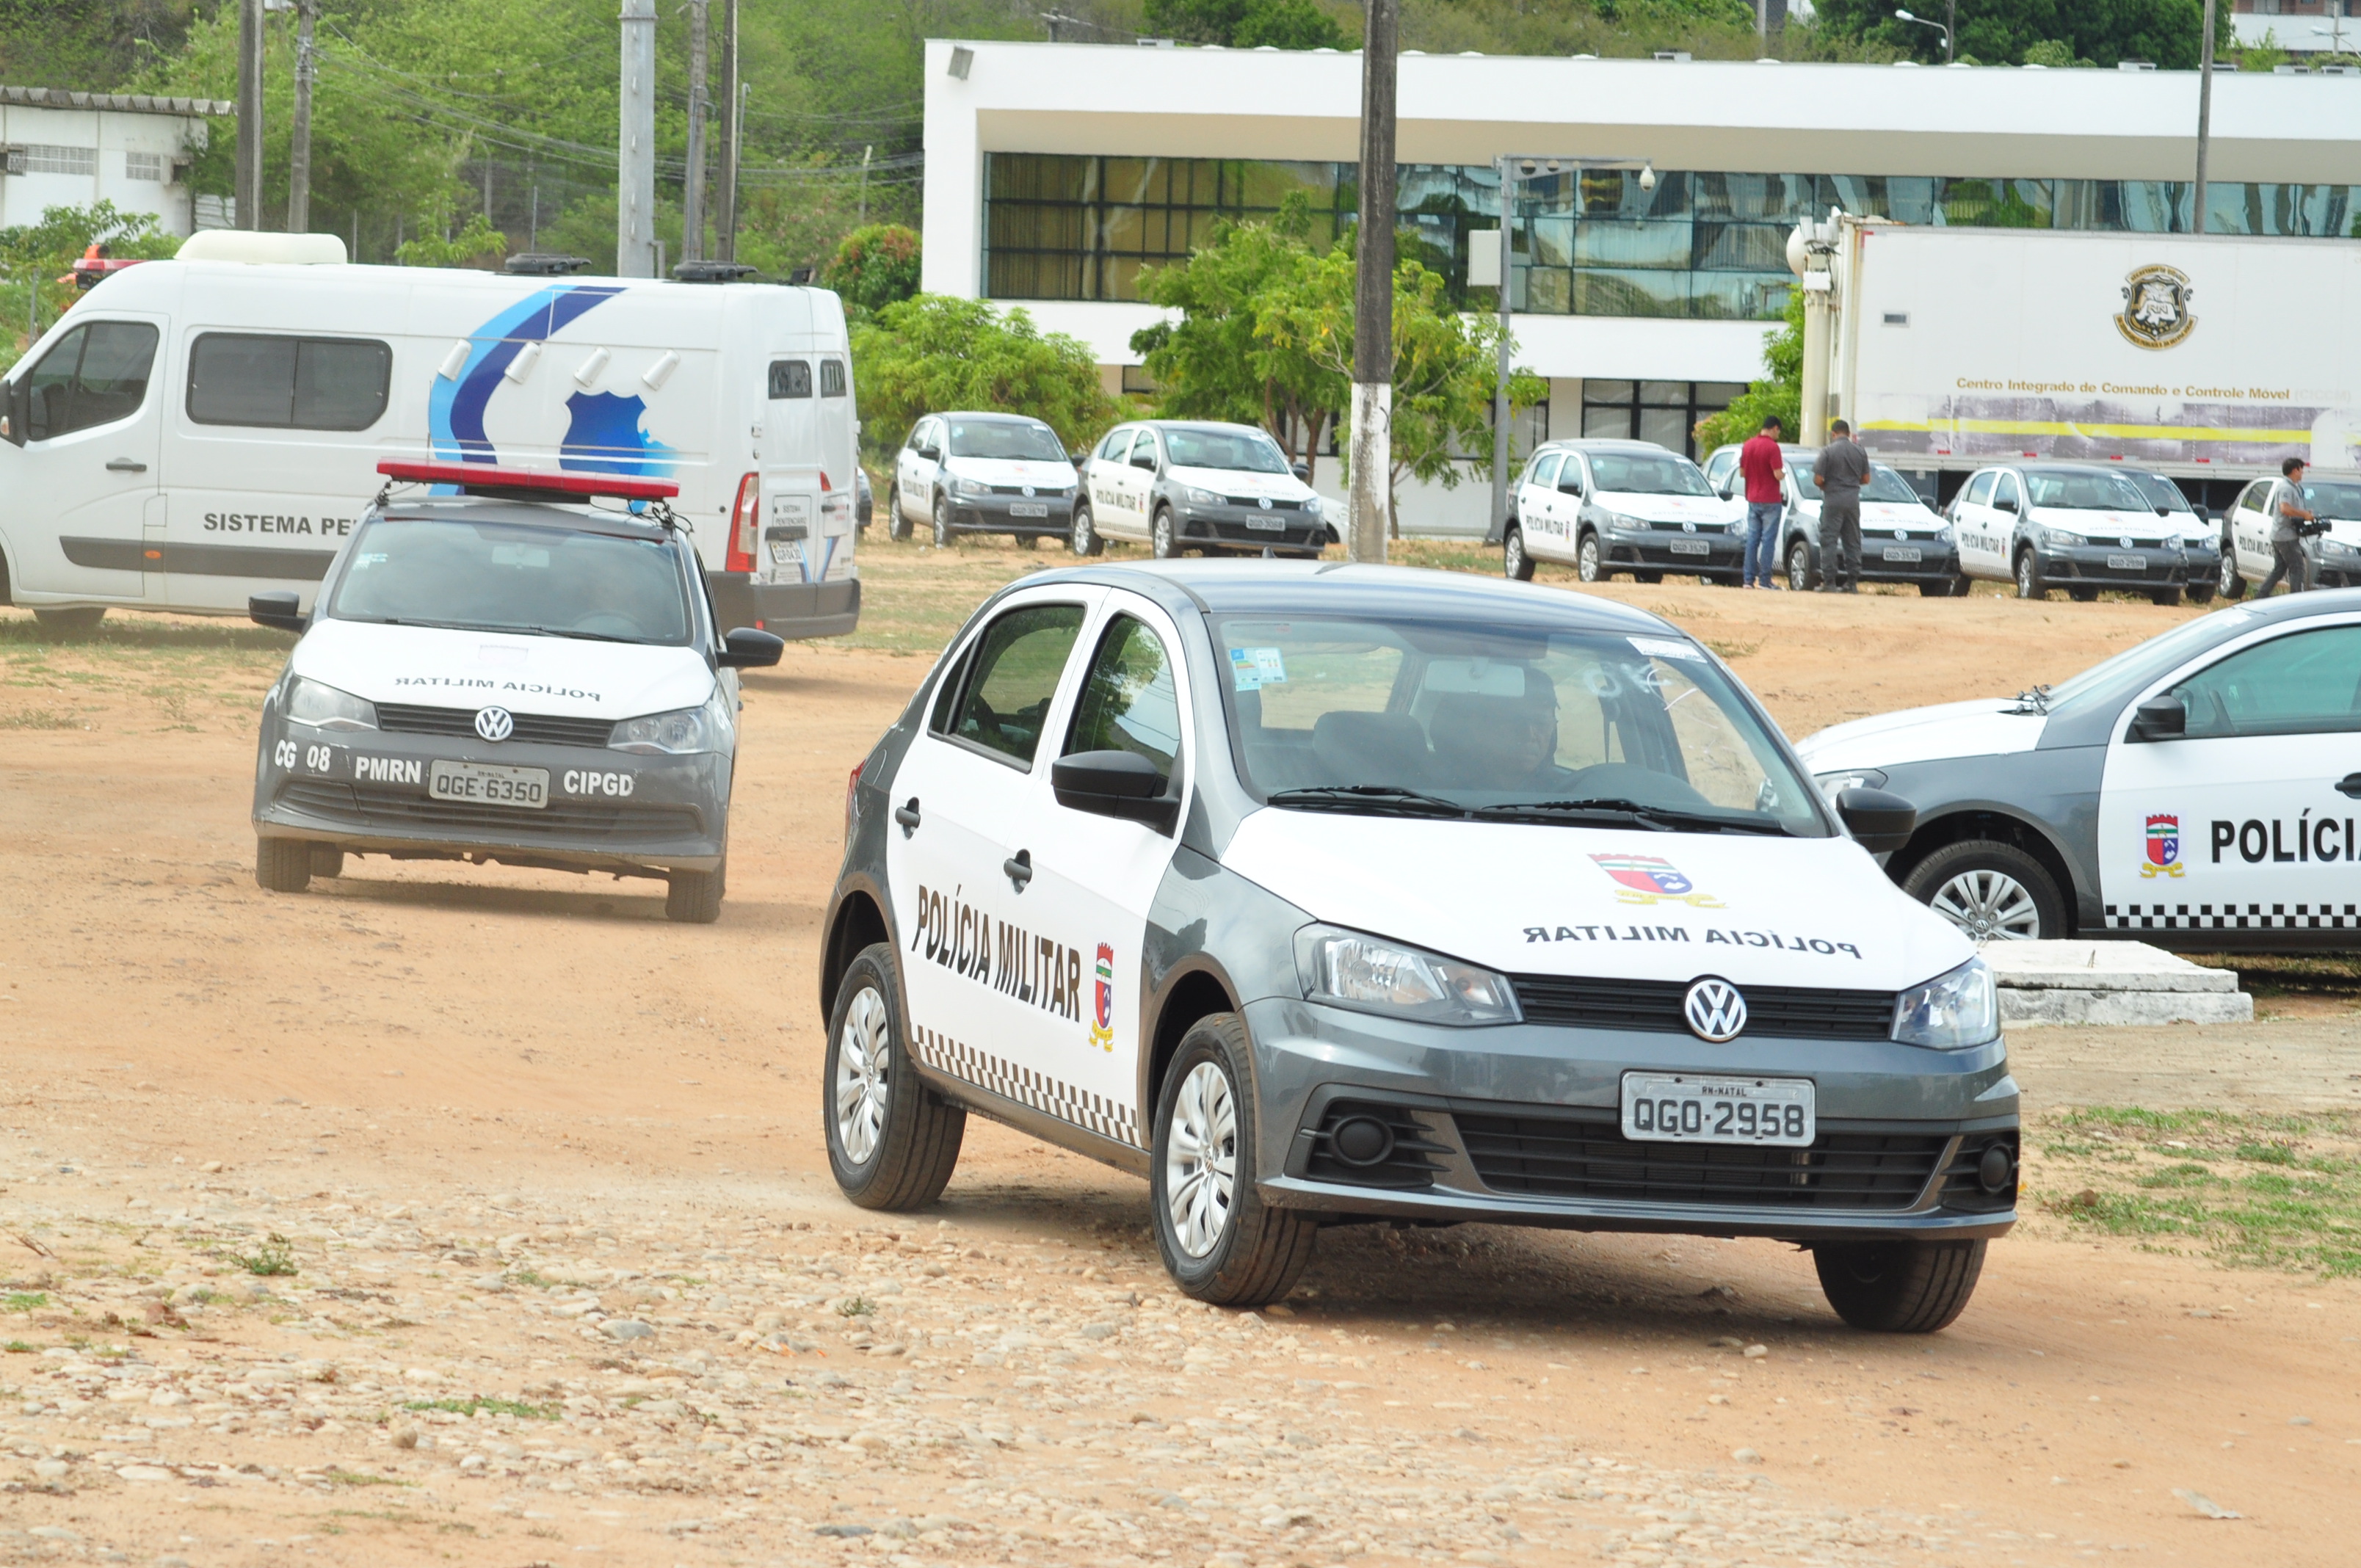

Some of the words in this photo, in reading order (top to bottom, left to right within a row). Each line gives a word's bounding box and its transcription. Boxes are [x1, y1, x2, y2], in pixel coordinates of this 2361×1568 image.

[1956, 377, 2003, 390] Centro
[2008, 379, 2075, 393] Integrado
[2080, 382, 2097, 393] de
[2102, 382, 2166, 395] Comando
[2172, 388, 2180, 396] e
[2186, 385, 2244, 398] Controle
[2249, 387, 2290, 399] Móvel
[203, 513, 313, 534] SISTEMA
[321, 518, 358, 536] PE
[275, 739, 297, 769] CG
[306, 744, 332, 772] 08
[355, 755, 421, 784] PMRN
[563, 770, 634, 797] CIPGD
[2211, 807, 2361, 864] POLÍCI
[911, 883, 991, 985] POLÍCIA
[994, 920, 1081, 1023] MILITAR
[1702, 1086, 1747, 1097] RN-NATAL
